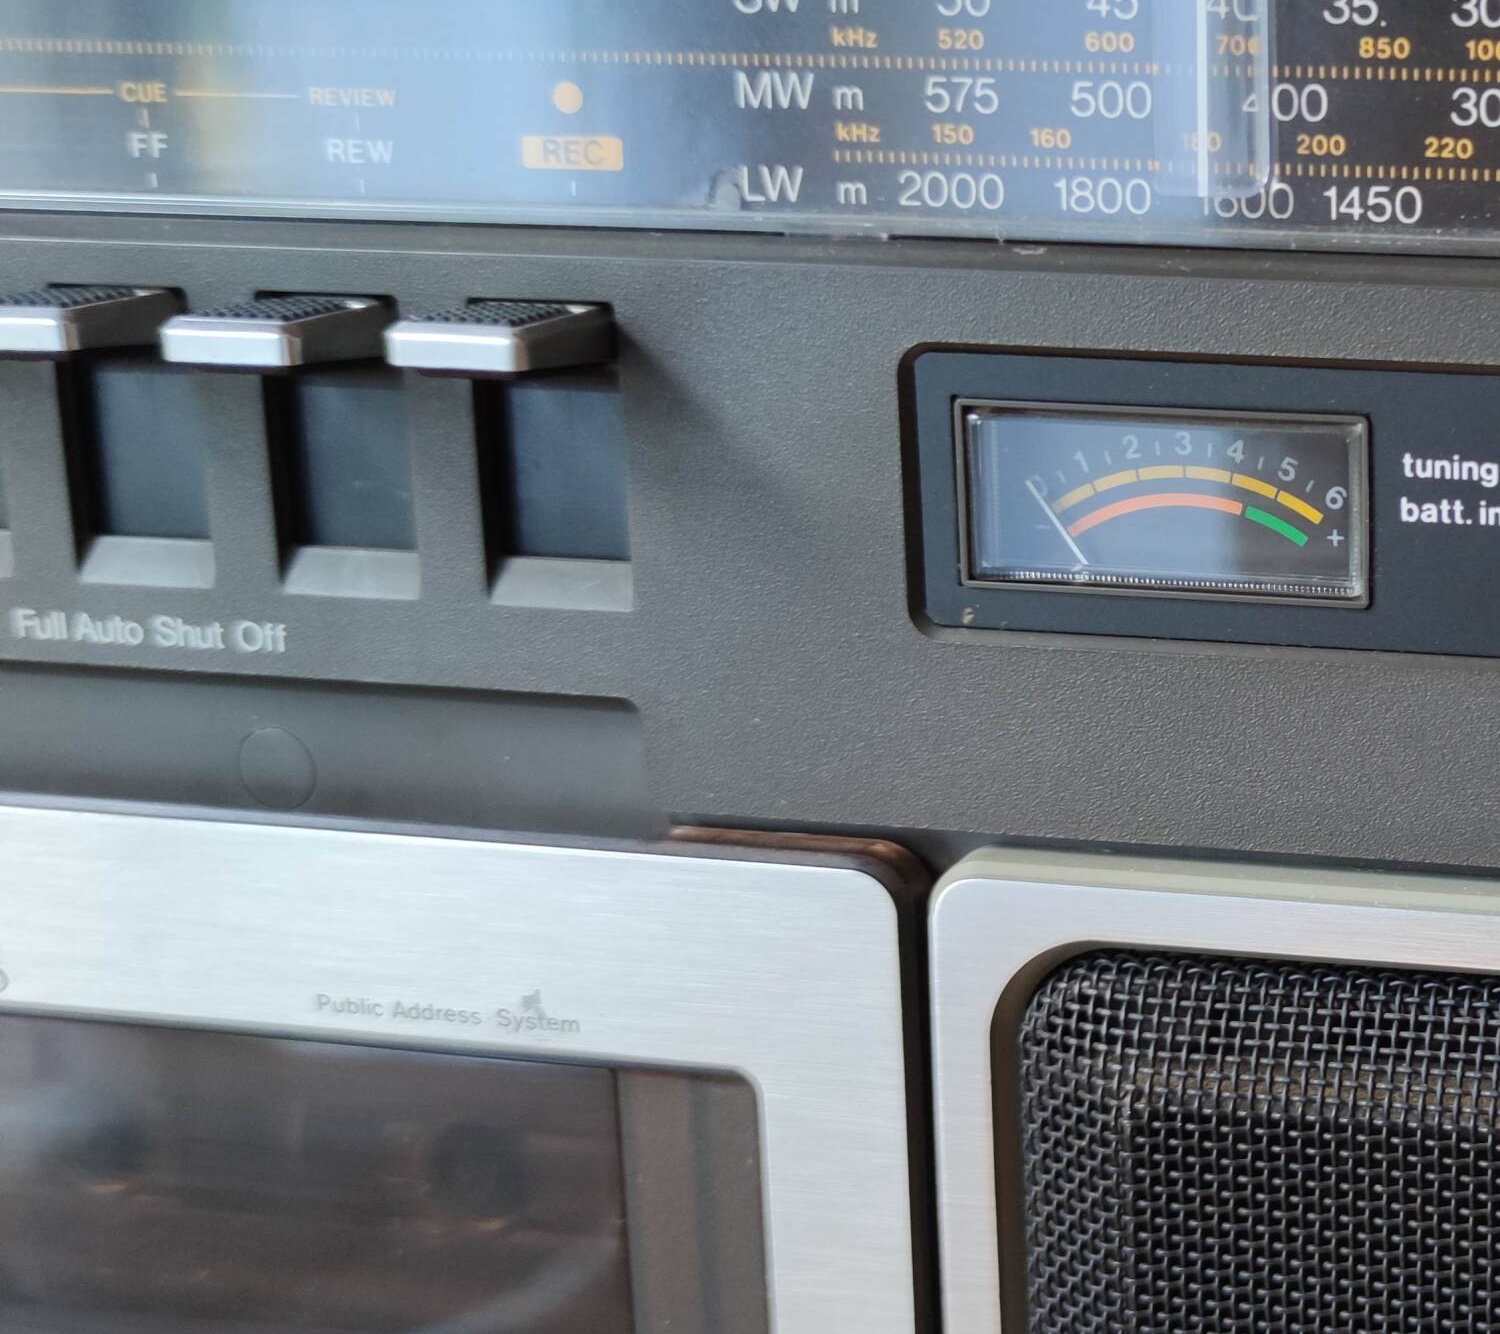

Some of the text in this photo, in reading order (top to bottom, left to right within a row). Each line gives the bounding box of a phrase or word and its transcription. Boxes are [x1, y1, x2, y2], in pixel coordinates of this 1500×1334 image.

[831, 27, 878, 49] kHz
[937, 30, 984, 51] 520
[1084, 32, 1135, 54] 600
[1358, 36, 1411, 60] 850
[118, 80, 396, 108] CUE REVIEW
[733, 72, 814, 110] MW
[834, 87, 864, 110] m
[924, 77, 999, 114] 575
[1070, 80, 1152, 119] 500
[127, 131, 169, 158] FF
[326, 138, 394, 165] REW
[541, 139, 605, 166] REC
[836, 122, 880, 144] kHz
[931, 124, 974, 146] 150
[1030, 128, 1071, 149] 160
[1296, 134, 1347, 156] 200
[1424, 137, 1474, 160] 220
[740, 166, 803, 203] LW
[837, 181, 867, 206] m
[900, 173, 1004, 210] 2000
[1053, 177, 1152, 215] 1800
[1323, 186, 1423, 224] 1450
[1073, 450, 1090, 473] 1
[1122, 434, 1142, 460] 2
[1174, 431, 1194, 456] 3
[1226, 439, 1246, 464] 4
[1277, 456, 1299, 482] 5
[1324, 485, 1348, 510] 6
[1402, 452, 1500, 488] tuning
[1400, 496, 1473, 526] batt.
[10, 607, 287, 654] Full Auto Shut Off
[315, 993, 581, 1037] Public Address System
